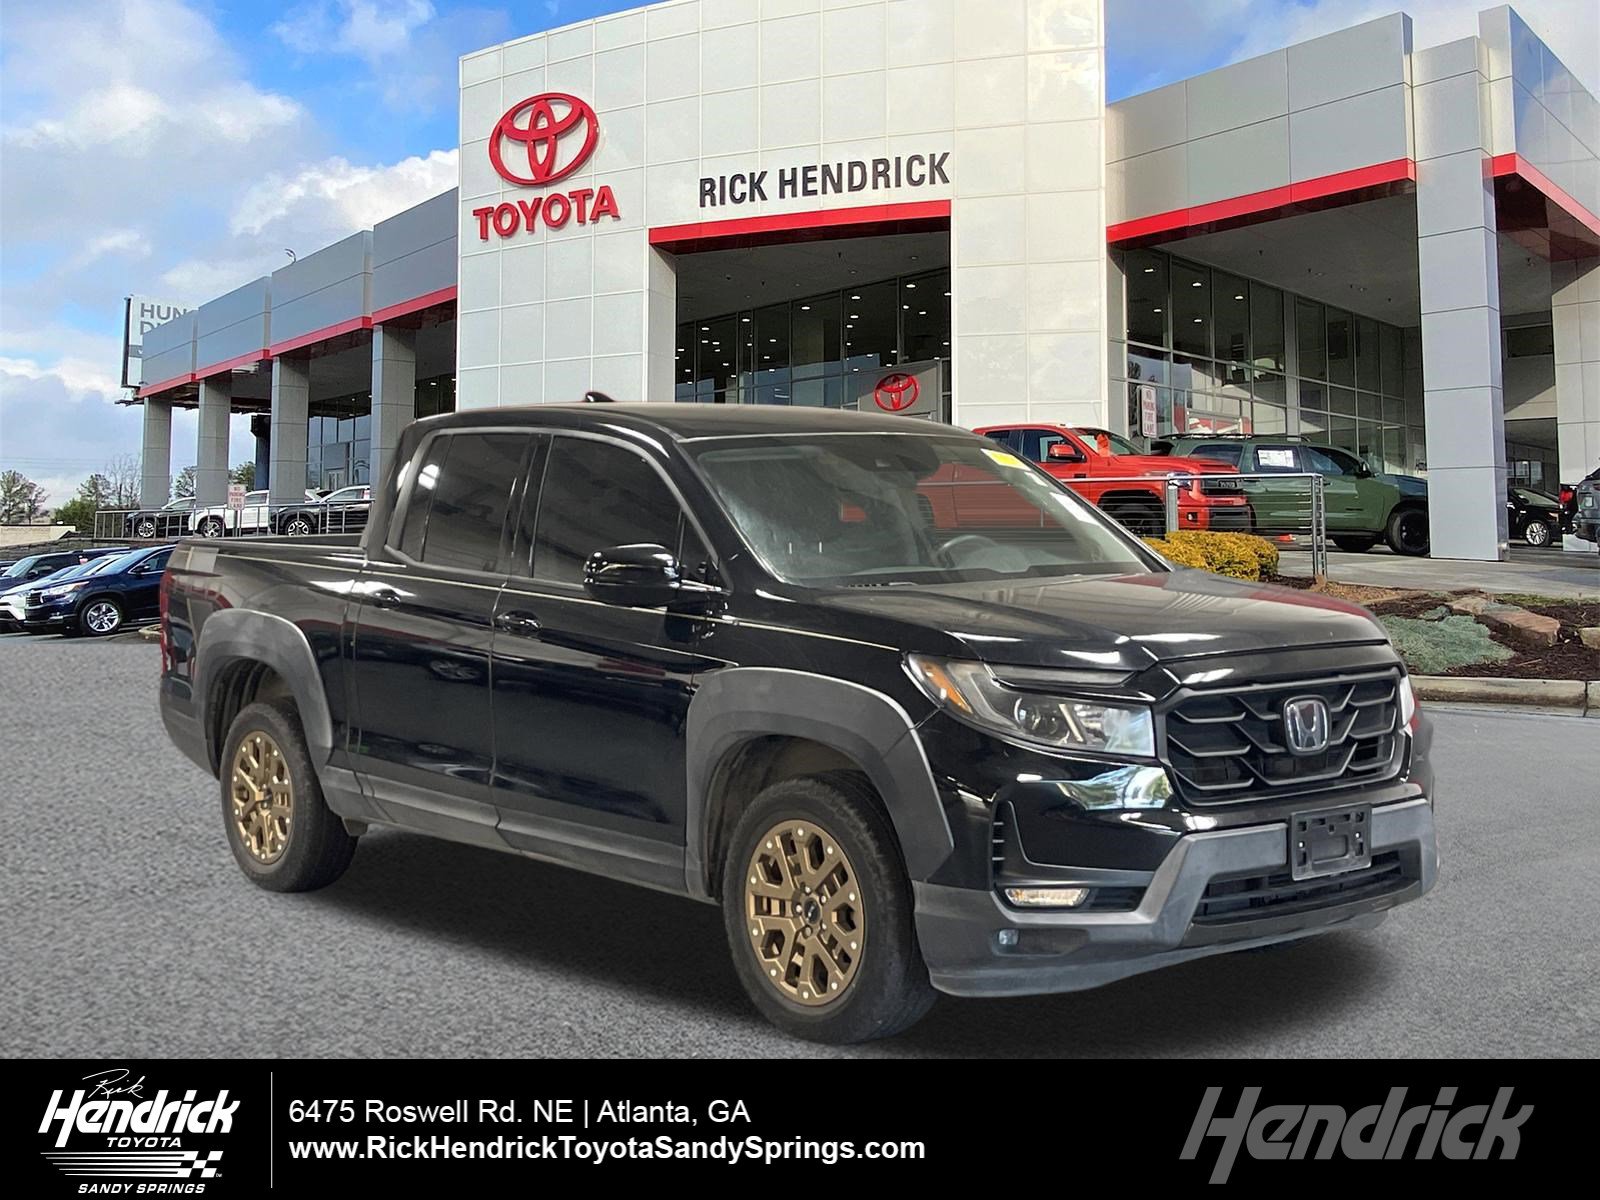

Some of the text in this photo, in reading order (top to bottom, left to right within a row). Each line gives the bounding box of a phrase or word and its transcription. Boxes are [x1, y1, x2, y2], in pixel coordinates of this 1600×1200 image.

[699, 152, 951, 208] RICK HENDRICK
[472, 185, 620, 240] TOYOTA
